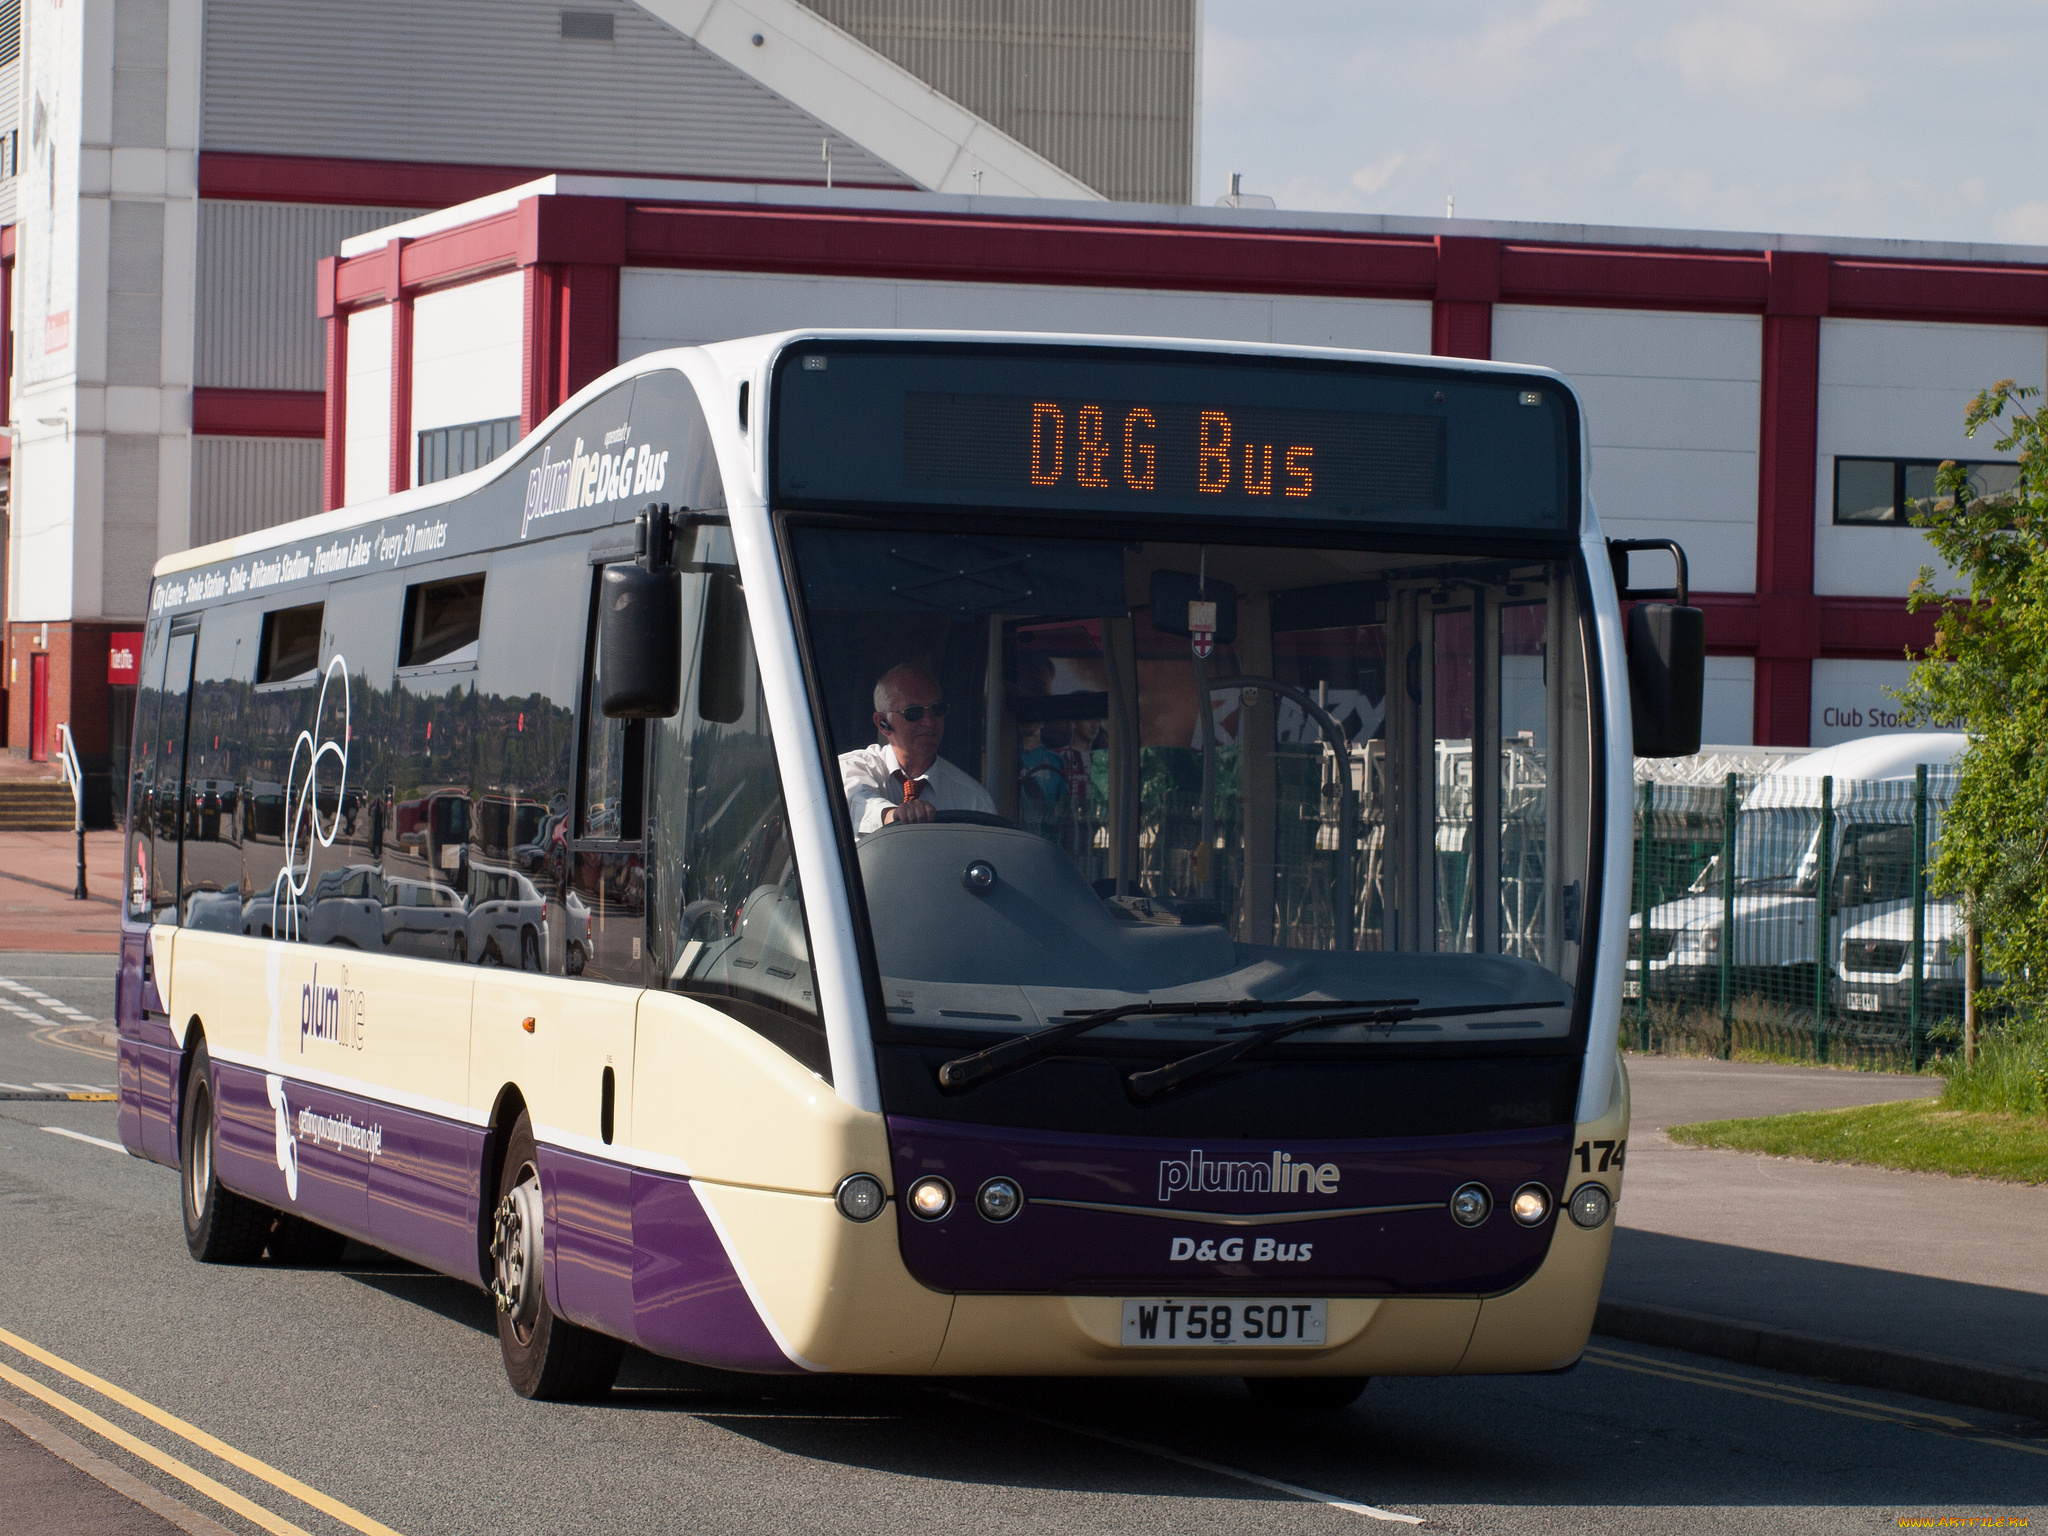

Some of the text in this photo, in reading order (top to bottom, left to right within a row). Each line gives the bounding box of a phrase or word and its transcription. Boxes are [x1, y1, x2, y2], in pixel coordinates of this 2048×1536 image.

[595, 443, 669, 504] D&G Bus
[1031, 402, 1314, 497] D&G Bus
[521, 437, 600, 539] plumline
[227, 563, 248, 595] Stoke
[249, 555, 281, 590] Britannia
[280, 550, 310, 583] Stadium
[313, 541, 349, 576] Trentham
[347, 534, 372, 568] Lakes
[380, 533, 404, 567] every
[402, 523, 415, 557] 30
[413, 519, 448, 553] minutes
[1823, 707, 1863, 727] Club
[300, 962, 366, 1054] plumline
[1158, 1149, 1341, 1201] plumline
[1169, 1237, 1313, 1262] D&G Bus
[1138, 1305, 1312, 1339] WT58 SOT
